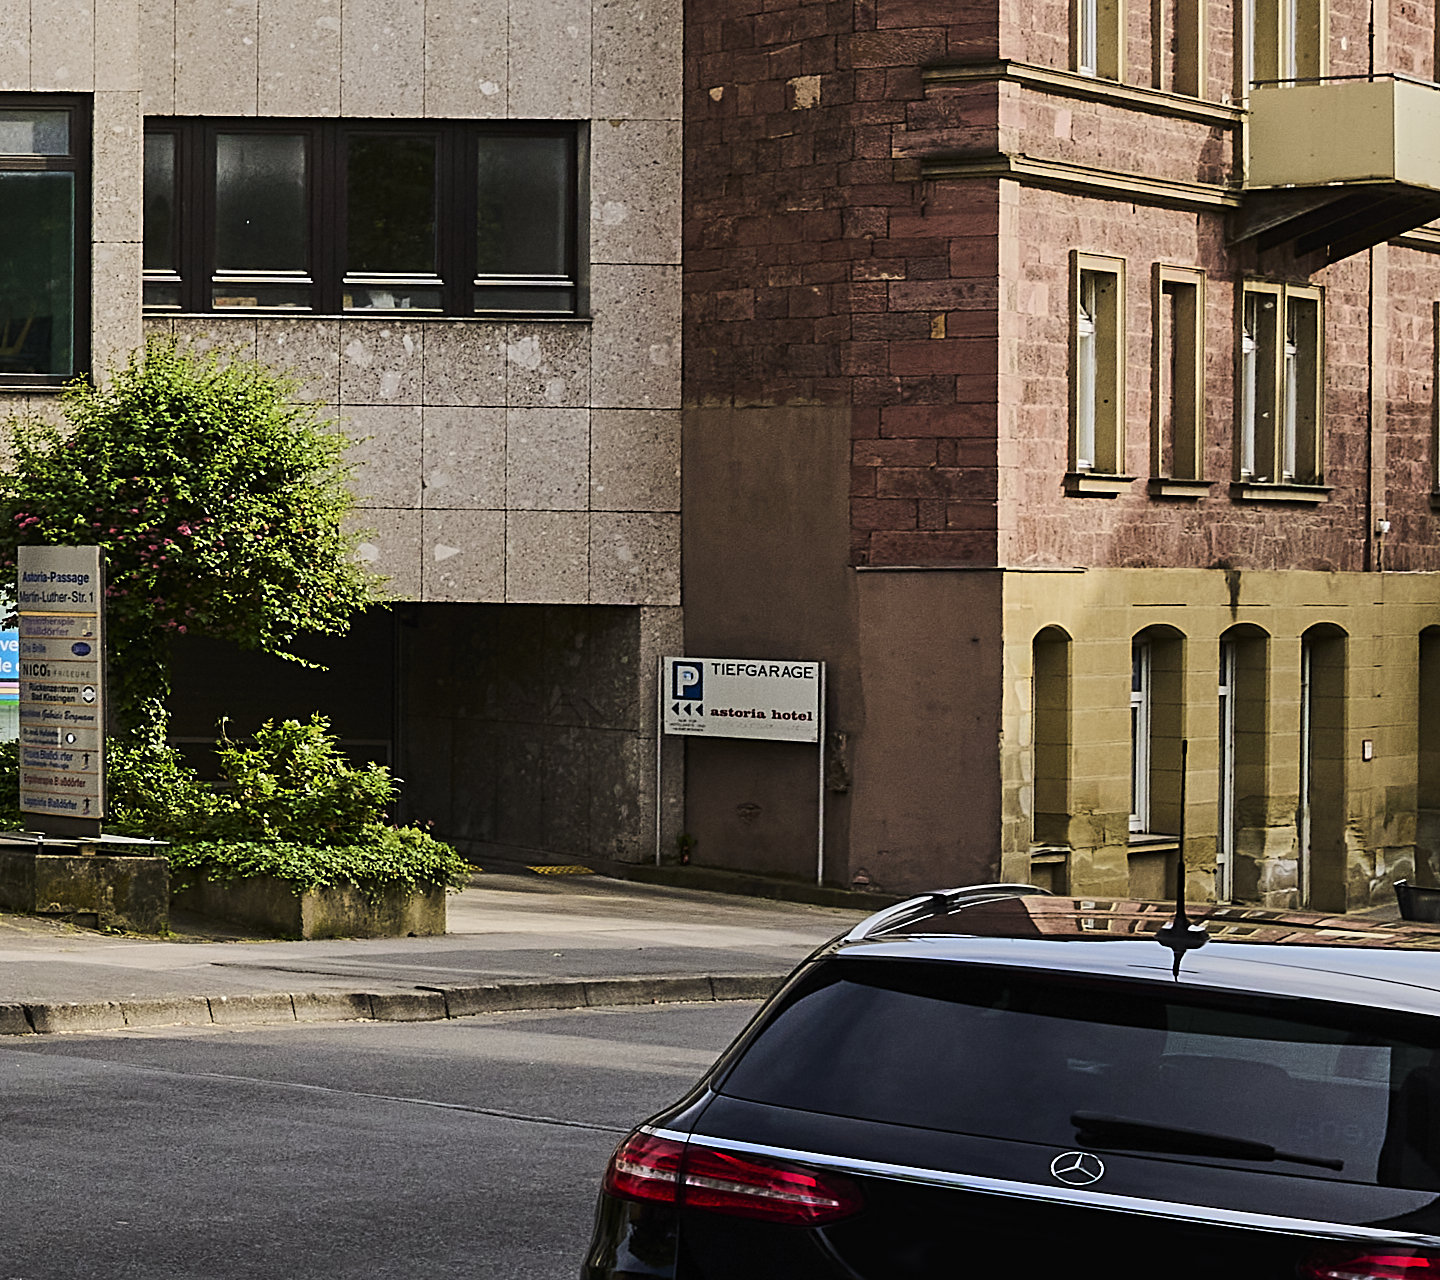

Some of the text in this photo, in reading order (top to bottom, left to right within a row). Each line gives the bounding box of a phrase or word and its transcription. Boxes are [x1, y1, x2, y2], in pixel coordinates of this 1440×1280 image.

[22, 571, 90, 586] Astoria-Passage
[89, 592, 94, 603] 1
[677, 662, 814, 696] P TIEFGARAGE
[43, 693, 76, 704] Kissingen
[710, 708, 813, 721] astoria hotel
